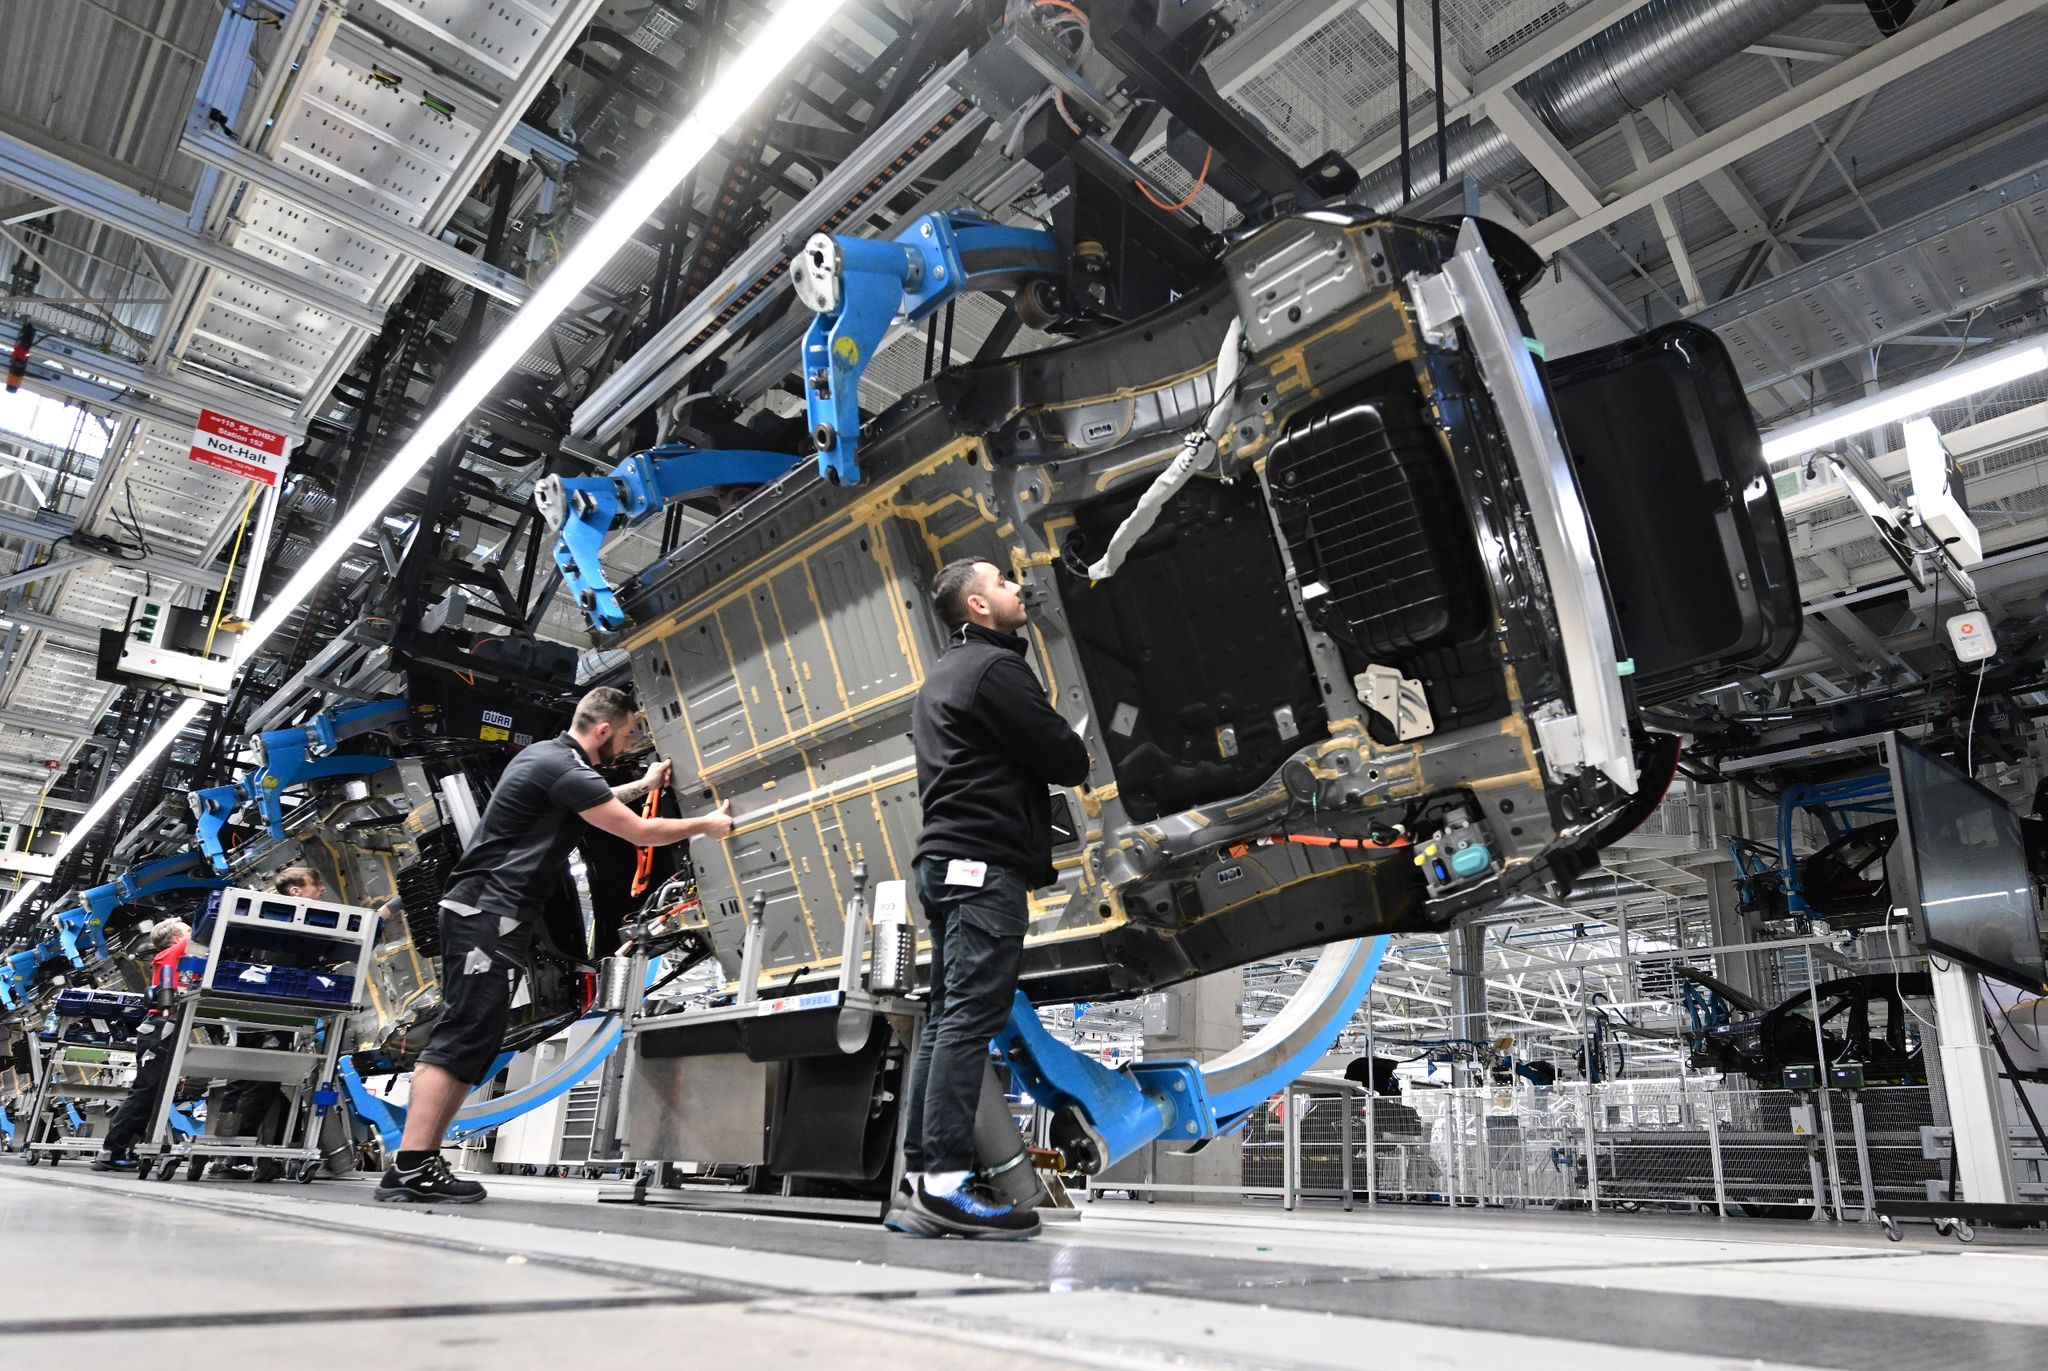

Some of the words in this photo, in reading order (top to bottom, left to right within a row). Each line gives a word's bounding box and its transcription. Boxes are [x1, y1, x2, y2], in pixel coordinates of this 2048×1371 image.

[218, 427, 247, 442] Station
[250, 438, 264, 447] 152
[207, 437, 267, 464] Not-Halt
